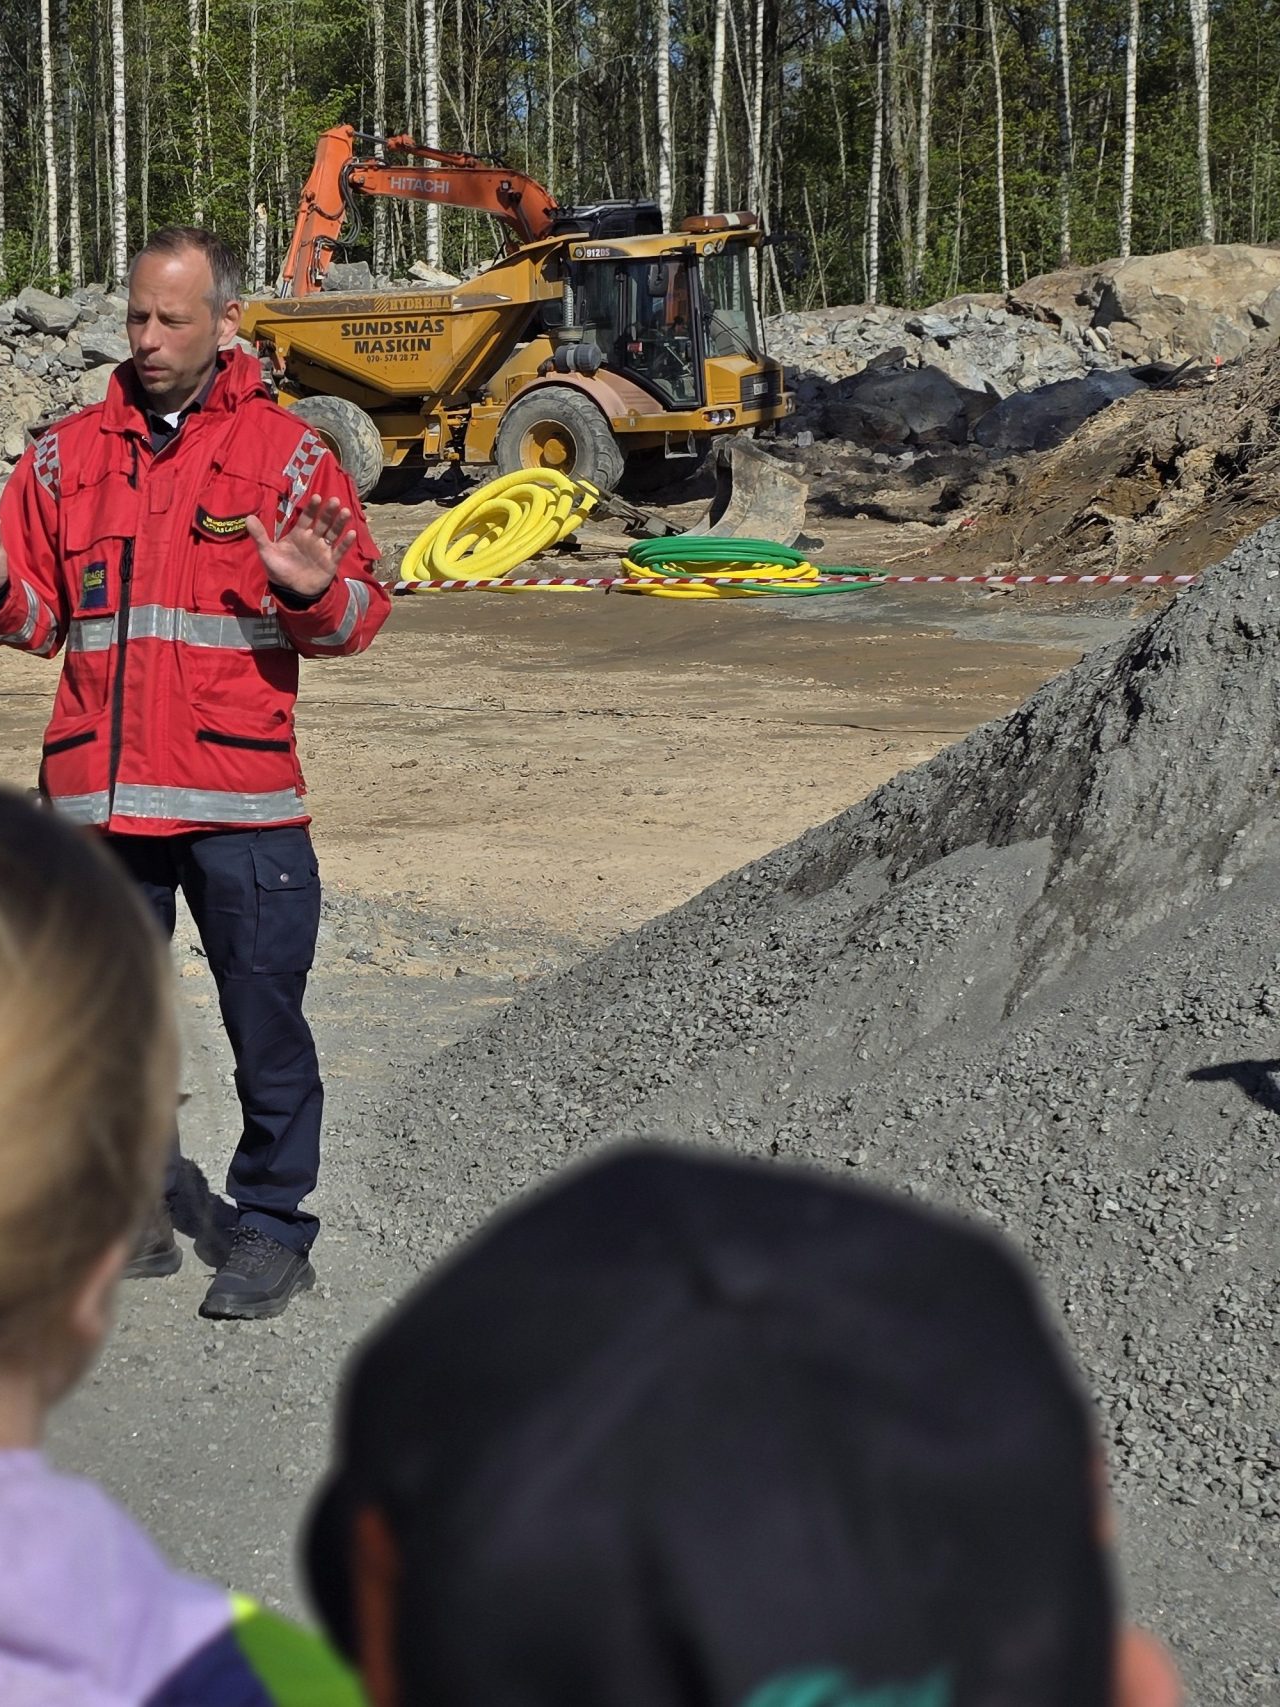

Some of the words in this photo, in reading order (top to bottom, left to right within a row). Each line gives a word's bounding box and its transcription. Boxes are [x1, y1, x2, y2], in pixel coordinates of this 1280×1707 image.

[390, 176, 450, 194] HITACHI
[586, 247, 611, 258] 912DS
[389, 296, 450, 311] HYDREMA
[341, 315, 445, 337] SUNDSNÄS
[354, 338, 431, 354] MASKIN
[384, 354, 398, 362] 574
[399, 354, 408, 362] 28
[410, 353, 419, 361] 72
